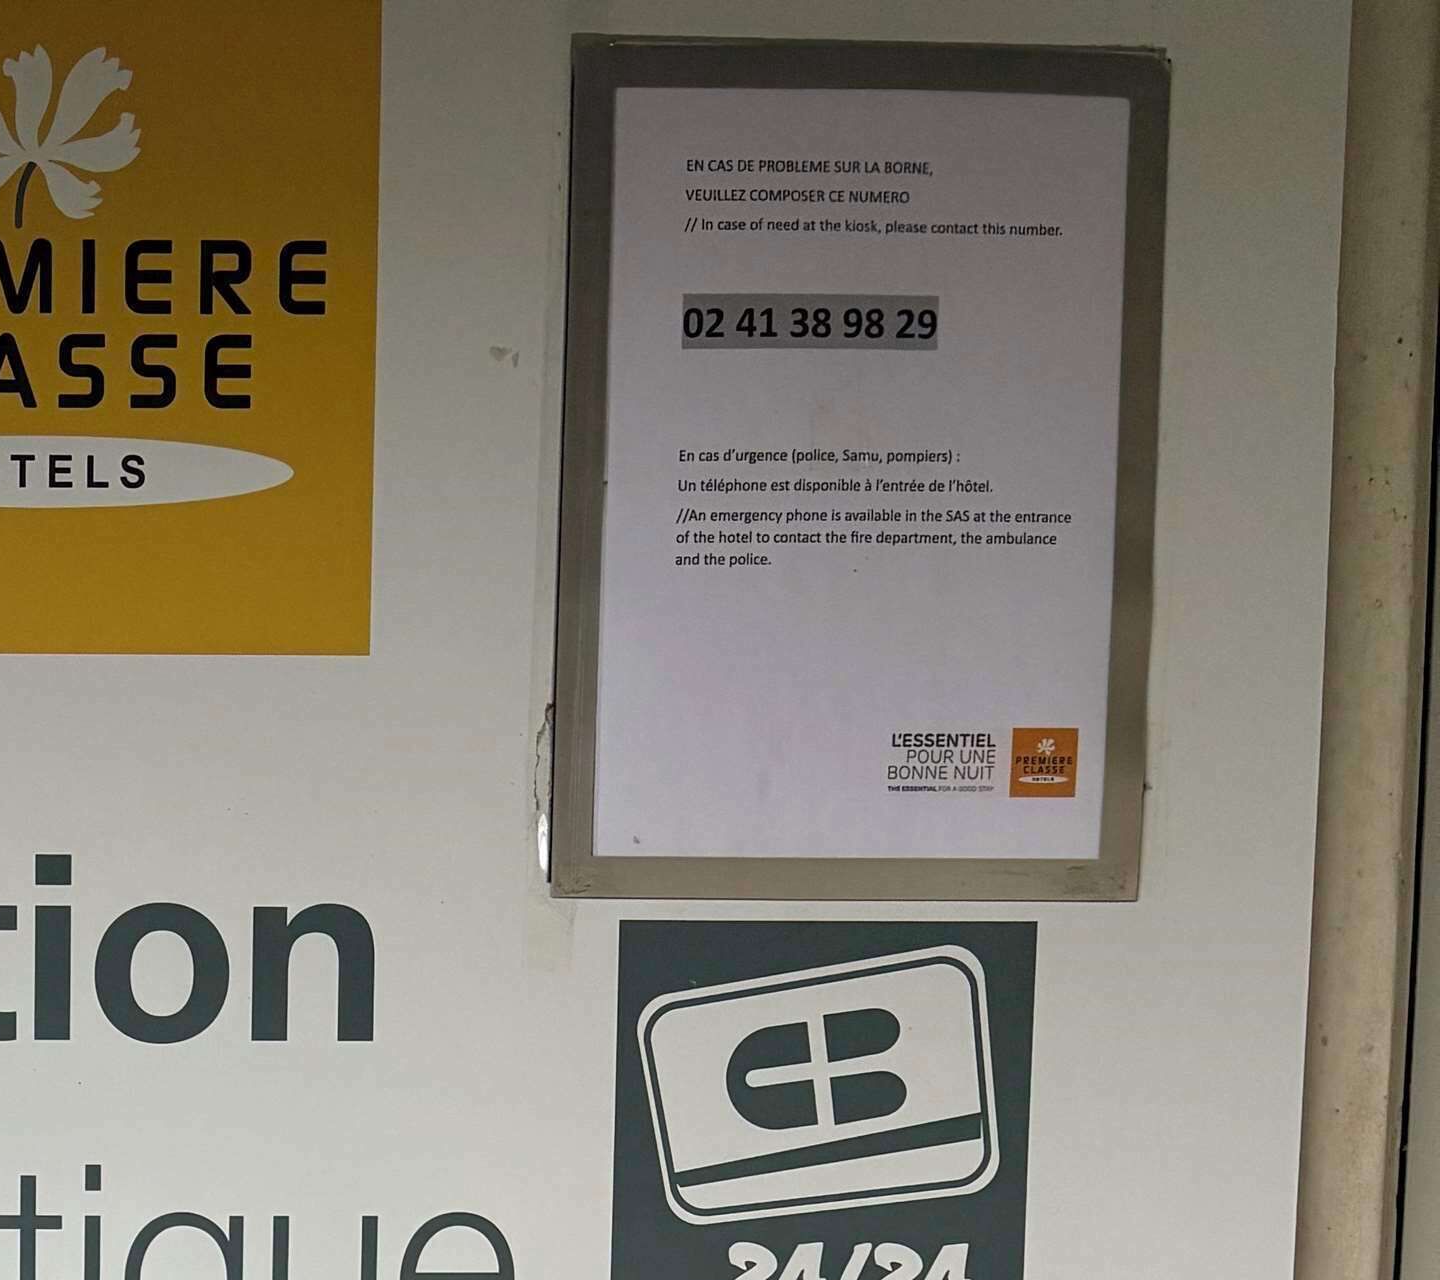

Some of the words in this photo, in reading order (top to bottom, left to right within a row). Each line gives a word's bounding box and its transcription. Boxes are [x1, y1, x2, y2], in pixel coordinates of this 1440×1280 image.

[686, 159, 705, 172] EN
[707, 159, 734, 173] CAS
[737, 159, 755, 173] DE
[758, 159, 831, 173] PROBLEME
[833, 160, 861, 174] SUR
[864, 161, 881, 174] LA
[884, 161, 933, 177] BORNE,
[685, 188, 747, 202] VEUILLEZ
[749, 188, 825, 203] COMPOSER
[828, 190, 845, 203] CE
[848, 190, 910, 204] NUMERO
[684, 308, 724, 338] 02
[736, 308, 777, 337] 41
[790, 308, 831, 337] 38
[844, 308, 884, 338] 98
[896, 309, 937, 339] 29
[679, 449, 695, 463] En
[698, 451, 720, 462] cas
[722, 448, 789, 465] d'urgence
[791, 448, 839, 465] (police,
[842, 448, 883, 465] Samu,
[886, 449, 953, 465] pompiers)
[677, 479, 697, 492] Un
[701, 478, 767, 494] téléphone
[770, 480, 791, 492] est
[793, 478, 861, 494] disponible
[864, 478, 872, 492] à
[875, 478, 926, 493] l'entrée
[928, 479, 946, 493] de
[948, 479, 993, 493] l'hôtel.
[709, 511, 783, 525] emergency
[785, 508, 828, 525] phone
[831, 508, 842, 522] is
[844, 508, 902, 522] available
[905, 509, 917, 522] in
[921, 508, 943, 523] the
[945, 509, 970, 523] SAS
[972, 511, 986, 523] at
[989, 509, 1012, 523] the
[1014, 512, 1072, 524] entrance
[891, 732, 997, 748] L'ESSENTIEL
[905, 748, 954, 765] POUR
[959, 749, 997, 765] UNE
[1015, 755, 1073, 766] PREMIERE
[887, 765, 948, 781] BONNE
[953, 765, 995, 781] NUIT
[1023, 765, 1065, 775] CLASSE
